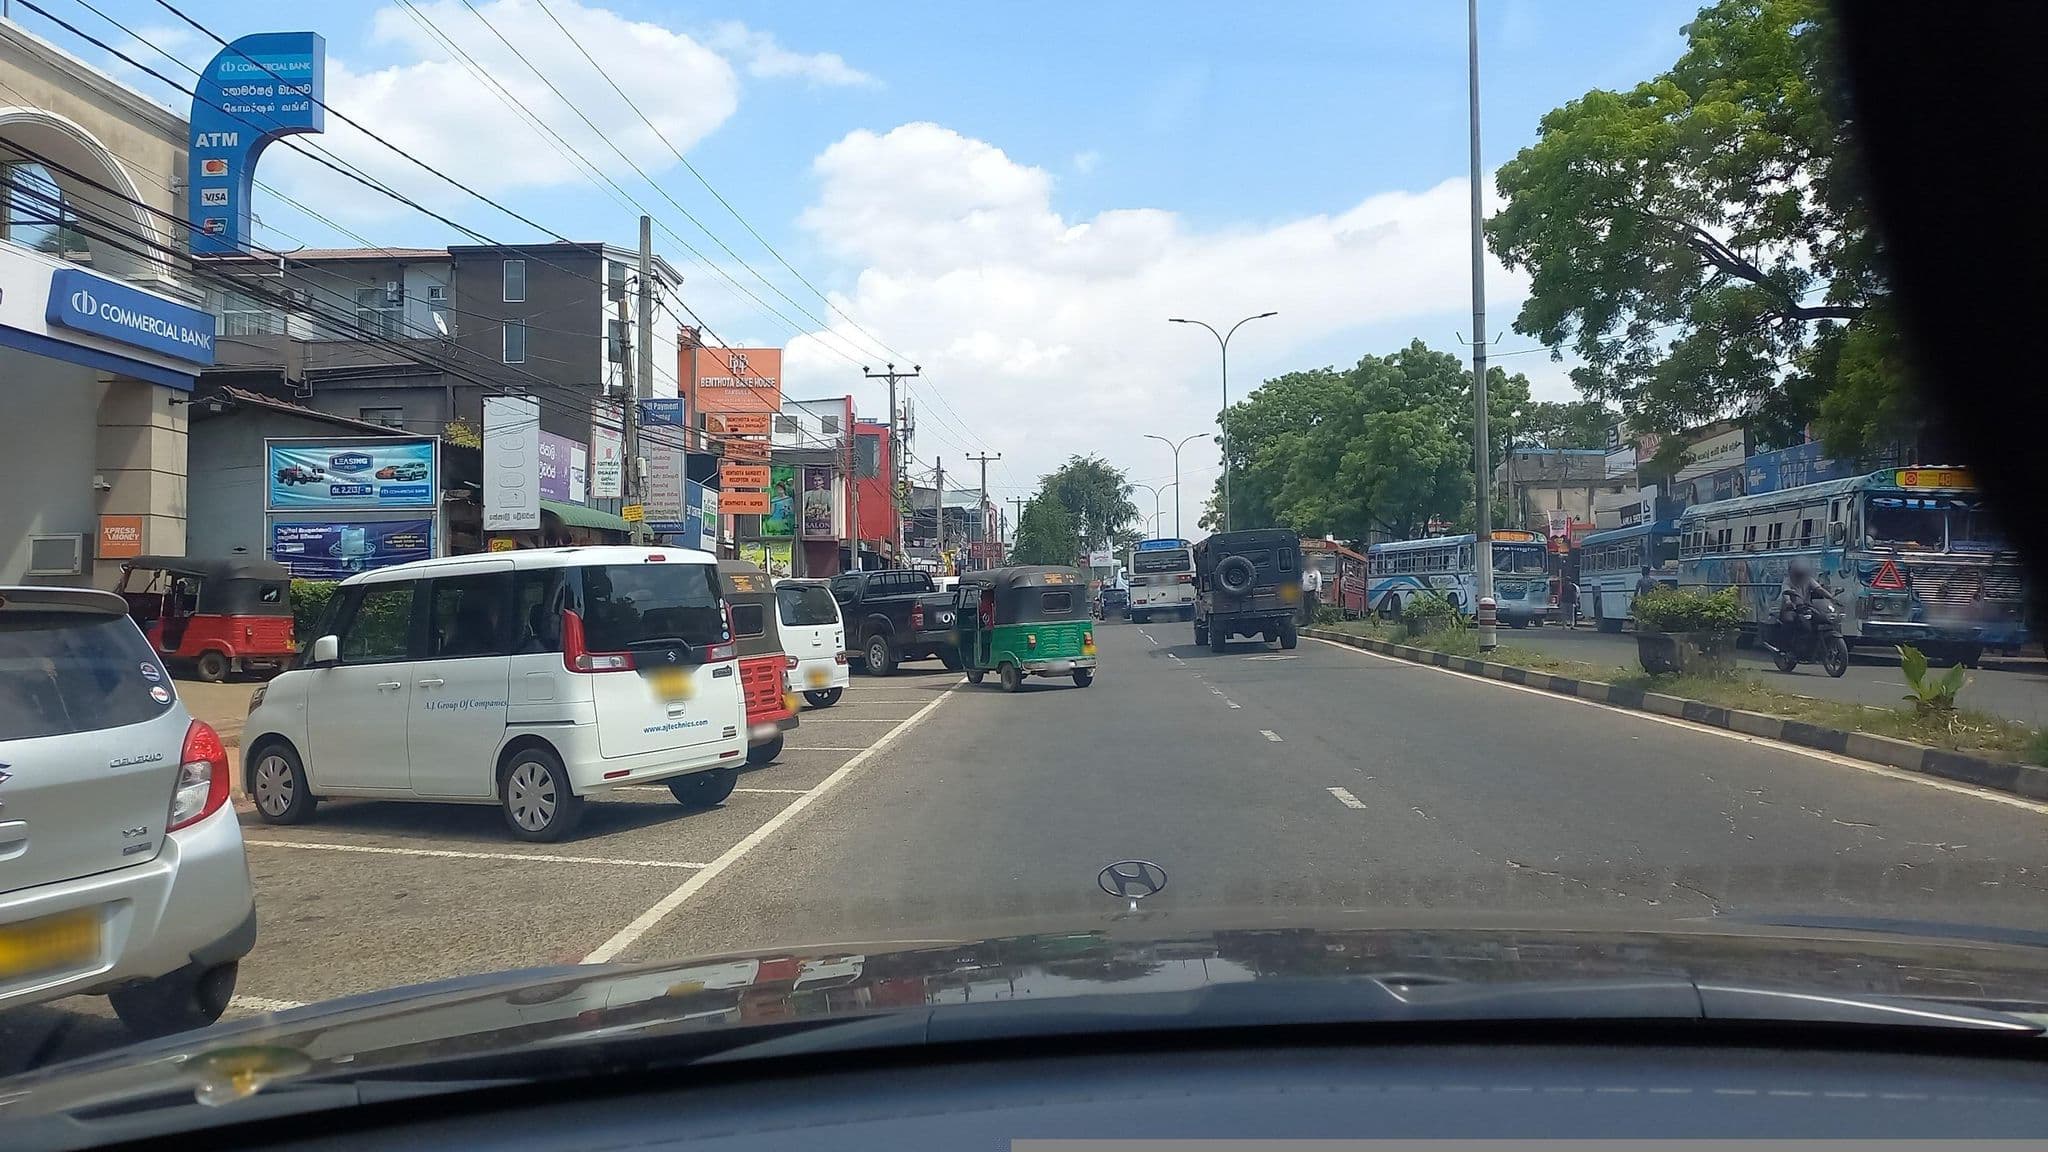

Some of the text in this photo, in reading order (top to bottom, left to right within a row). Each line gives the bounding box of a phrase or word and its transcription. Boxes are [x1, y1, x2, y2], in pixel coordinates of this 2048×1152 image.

[289, 61, 311, 70] BANK
[195, 133, 238, 147] ATM
[205, 193, 226, 201] VISA
[100, 303, 211, 350] COMMERCIAL BANK
[701, 377, 734, 388] BENTHOTA
[653, 402, 679, 411] Payment
[334, 457, 369, 465] LEASING
[109, 533, 140, 541] MONEY
[437, 701, 459, 711] Group
[459, 699, 469, 710] Of
[469, 699, 507, 710] Companies
[643, 719, 709, 734] www.ajtechnics.com
[109, 751, 164, 768] CELERIO
